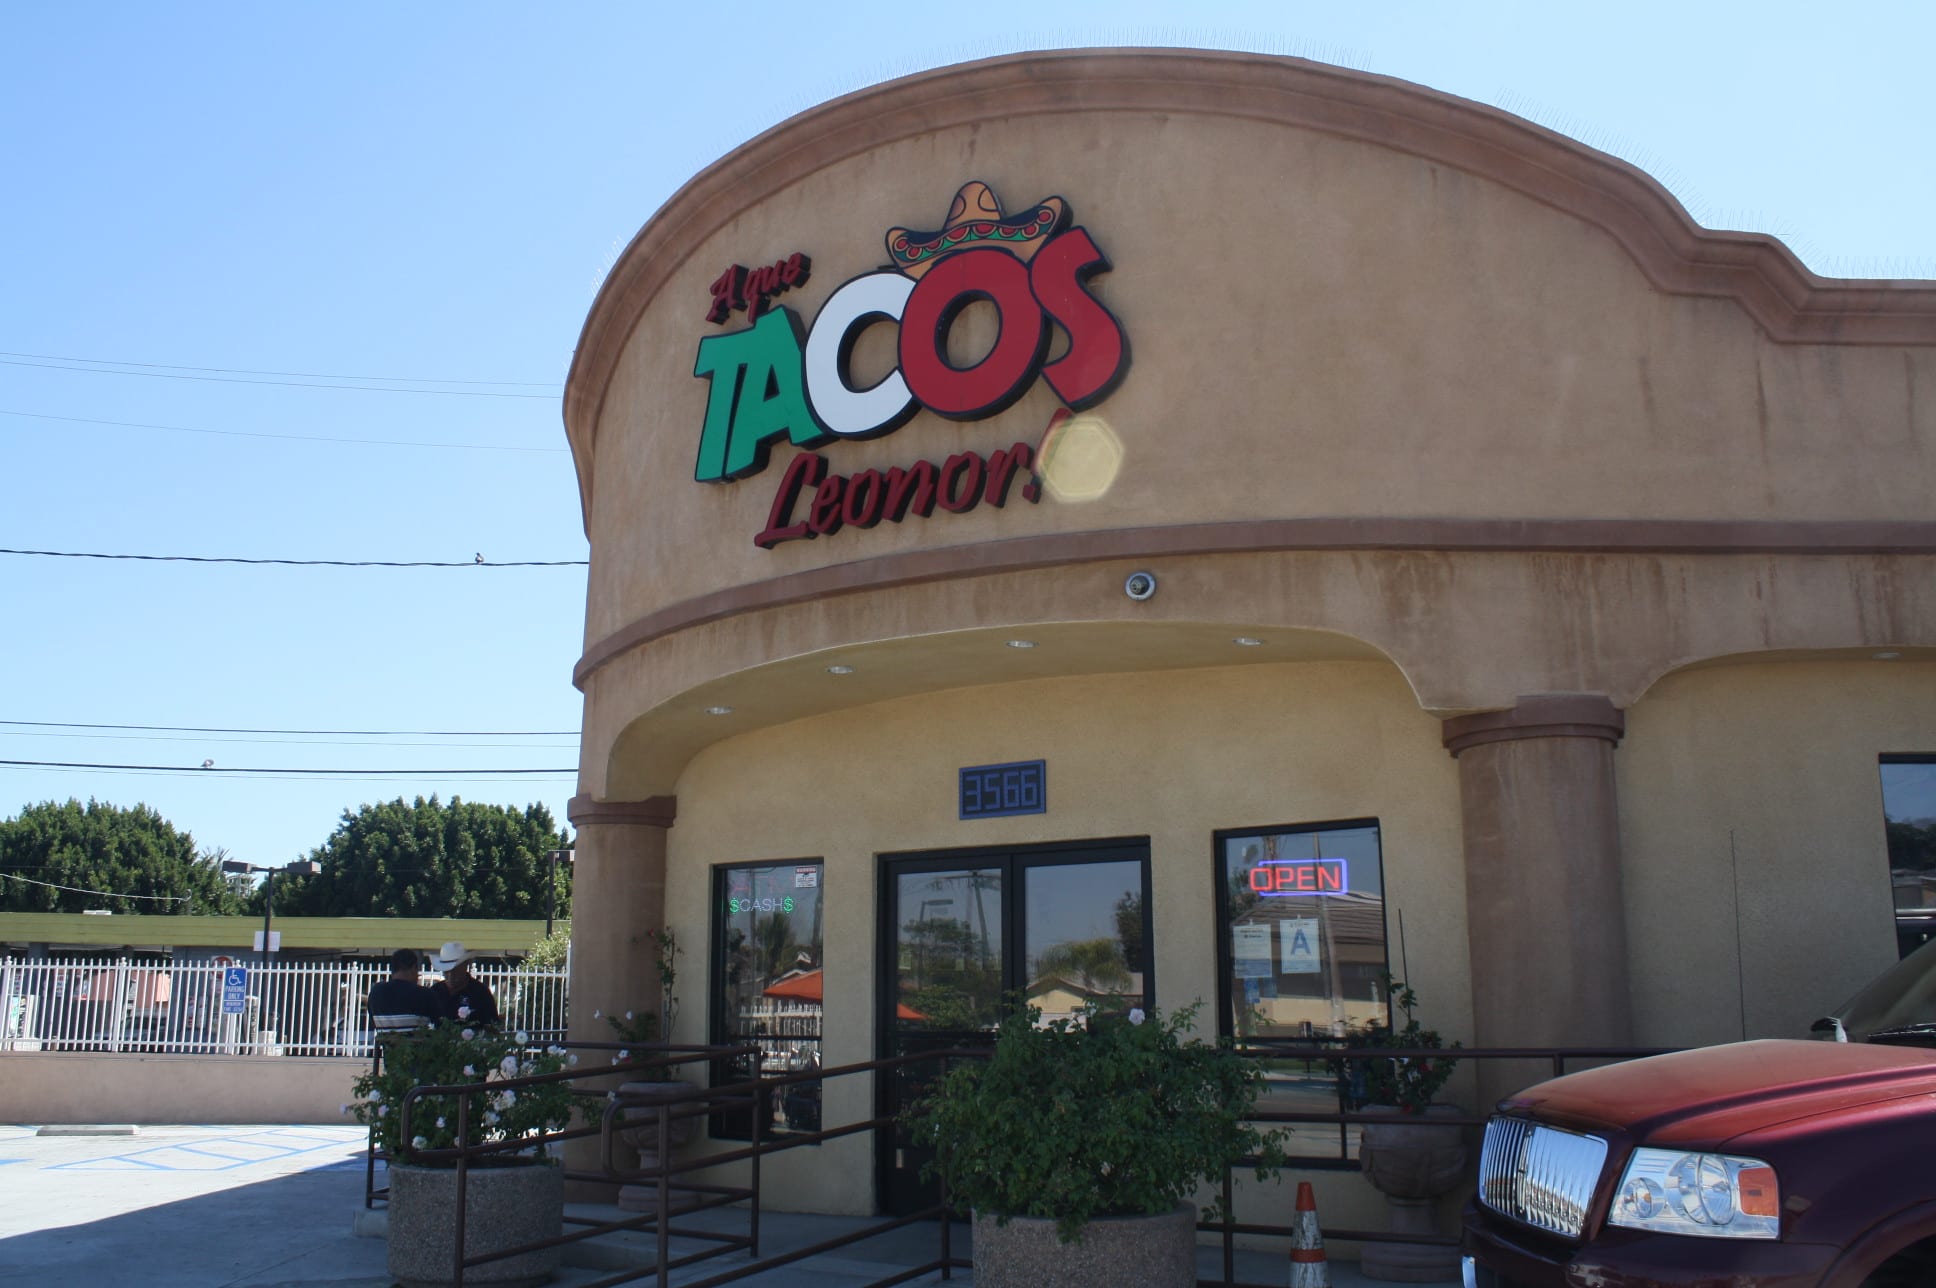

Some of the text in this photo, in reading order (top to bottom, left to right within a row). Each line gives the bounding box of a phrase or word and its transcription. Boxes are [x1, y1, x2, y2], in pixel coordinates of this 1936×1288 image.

[694, 226, 1127, 482] TACOS
[964, 769, 1038, 812] 3566
[1250, 866, 1341, 891] OPEN
[1290, 928, 1312, 955] A
